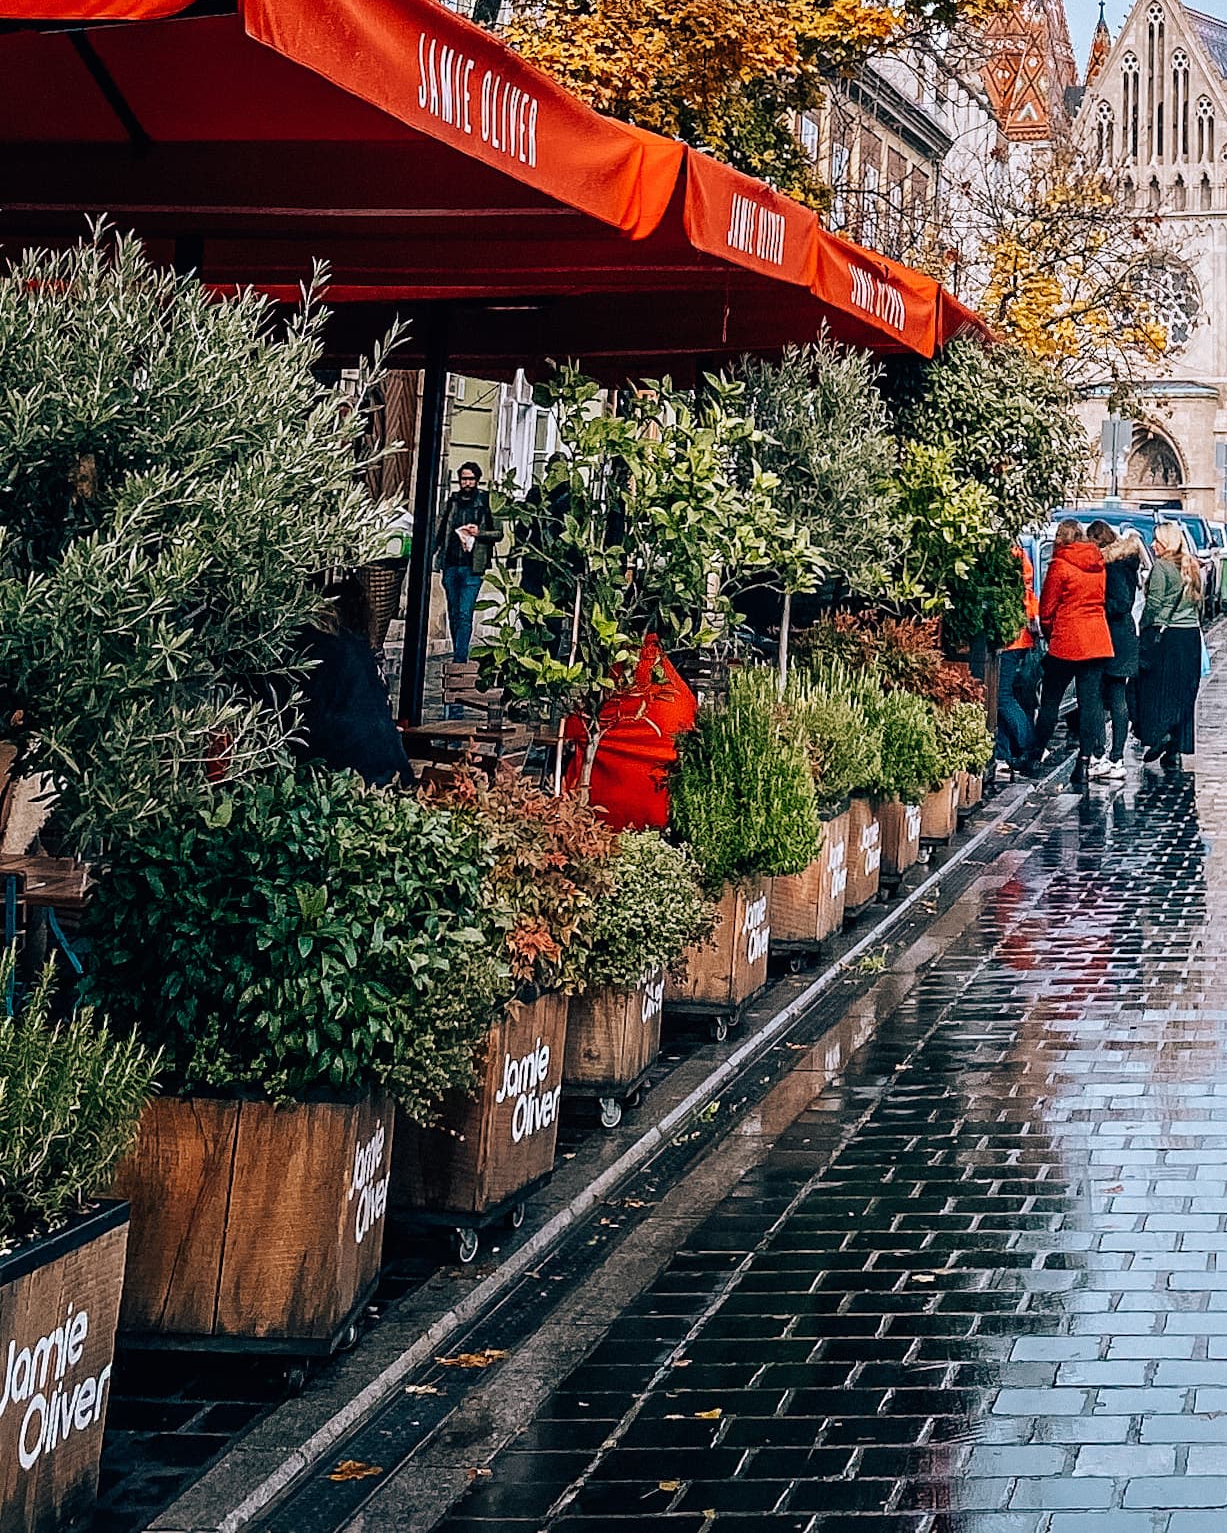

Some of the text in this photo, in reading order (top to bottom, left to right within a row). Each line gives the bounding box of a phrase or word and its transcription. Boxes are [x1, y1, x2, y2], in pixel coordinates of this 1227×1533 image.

[419, 32, 538, 169] JAMIE OLIVER
[495, 1036, 550, 1104] Jamie
[512, 1083, 562, 1143] Oliver
[0, 1301, 89, 1417] Jamie
[18, 1362, 113, 1471] Oliver
